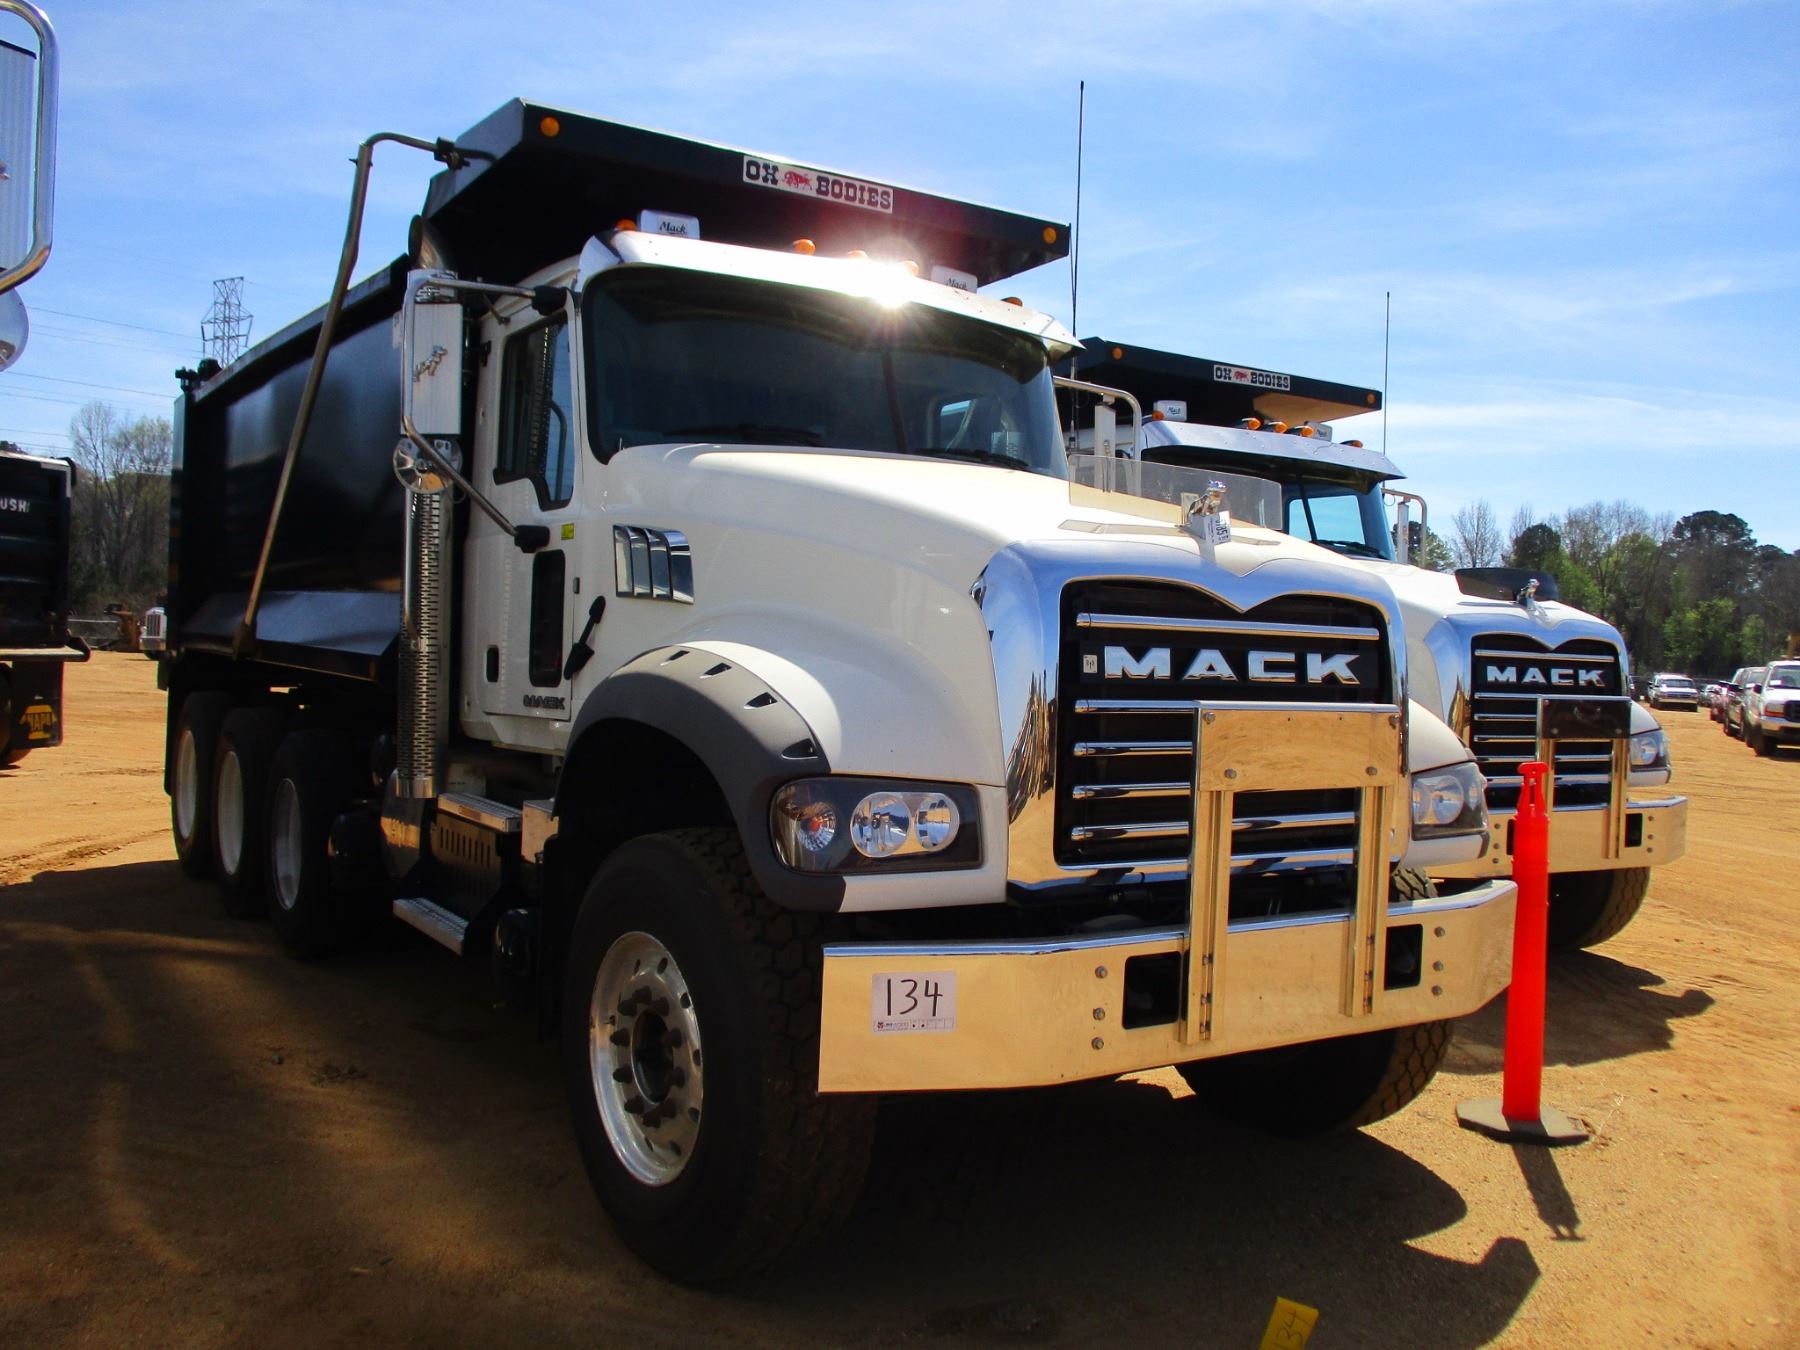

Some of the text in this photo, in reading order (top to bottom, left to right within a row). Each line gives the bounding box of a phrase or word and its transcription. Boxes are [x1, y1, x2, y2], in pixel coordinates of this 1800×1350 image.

[745, 160, 891, 210] OX BODIES
[659, 221, 687, 234] Mack
[1215, 366, 1289, 389] OX BODIES
[1104, 646, 1360, 685] MACK
[1486, 665, 1606, 687] MACK
[887, 978, 943, 1017] 134
